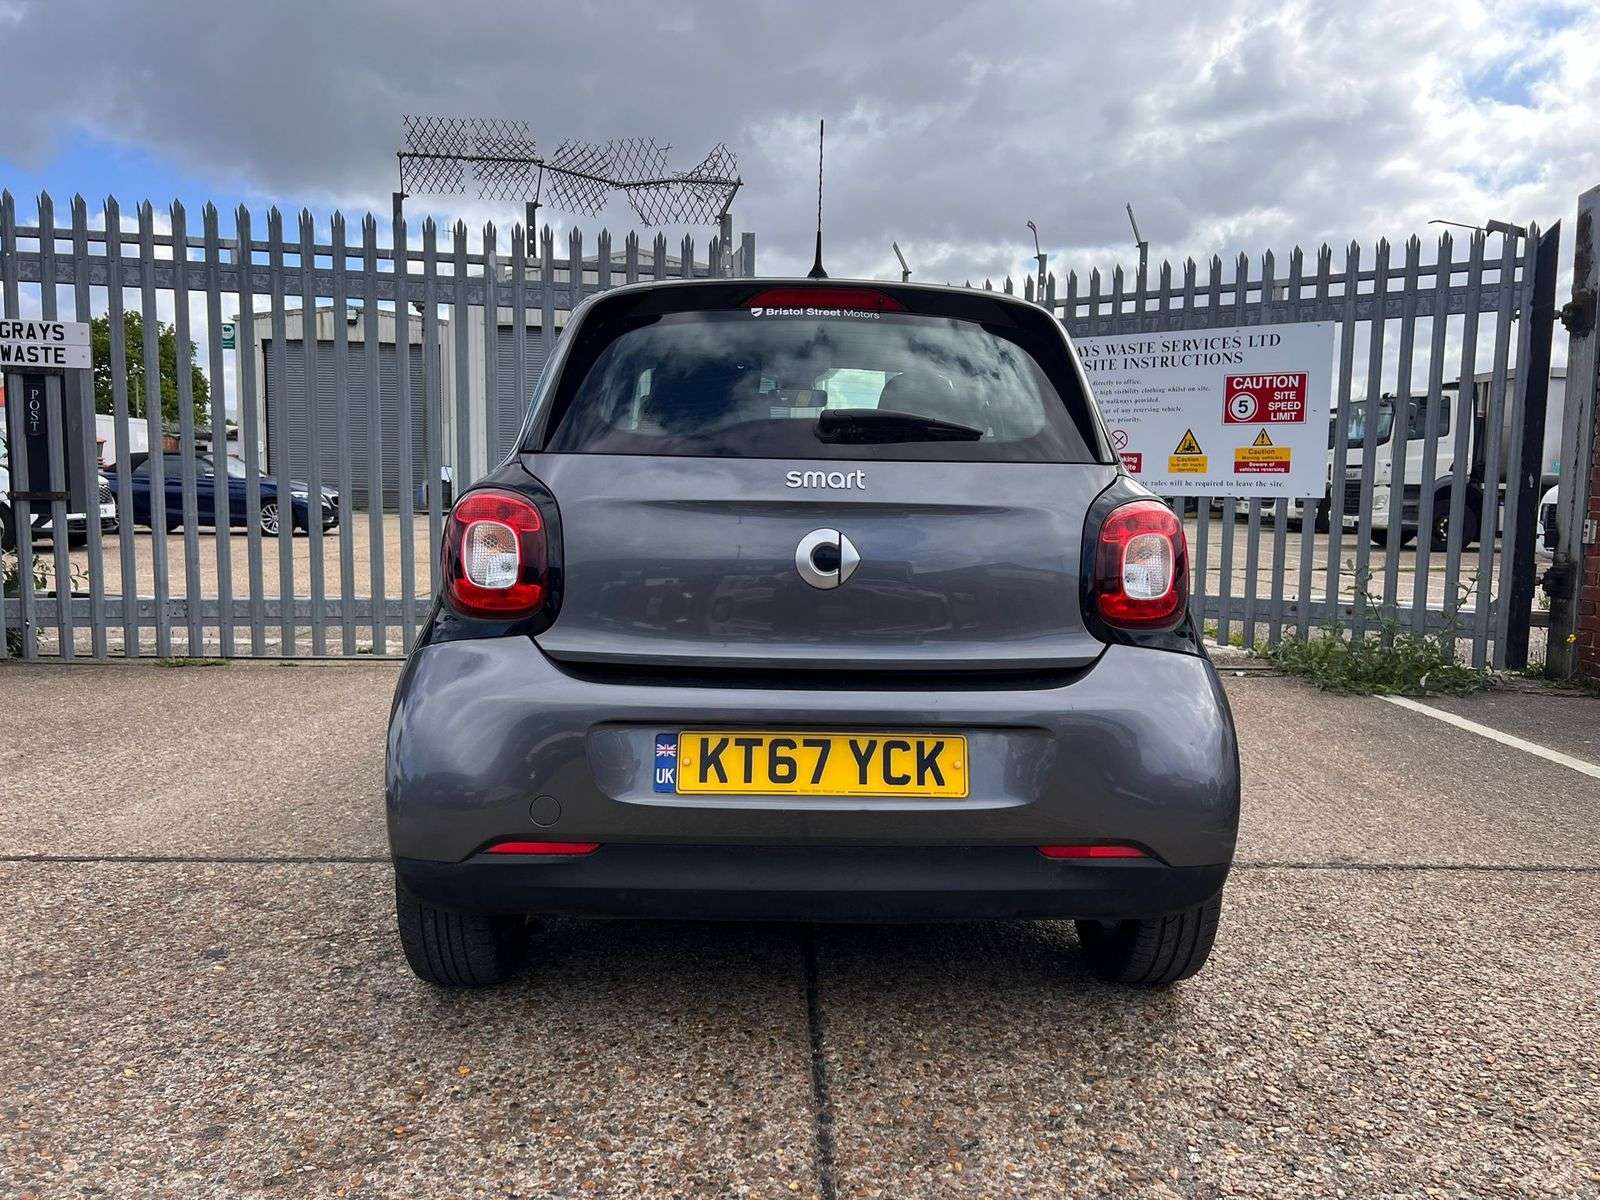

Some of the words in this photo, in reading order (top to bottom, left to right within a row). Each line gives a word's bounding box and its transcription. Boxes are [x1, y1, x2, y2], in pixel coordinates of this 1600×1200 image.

[766, 307, 803, 316] Bristol
[806, 307, 841, 317] Street
[844, 309, 880, 320] Motors
[0, 321, 65, 341] GRAYS
[1076, 344, 1100, 358] AYS
[1105, 341, 1156, 356] WASTE
[1161, 335, 1242, 353] SERVICES
[1249, 333, 1281, 348] LTD
[0, 344, 67, 364] WASTE
[1084, 358, 1117, 372] SITE
[1123, 351, 1243, 370] INSTRUCTIONS
[1232, 375, 1299, 390] CAUTION
[1273, 390, 1297, 400] SITE
[29, 389, 40, 432] POST
[1237, 400, 1249, 414] 5
[1267, 401, 1302, 411] SPEED
[1270, 411, 1297, 421] LIMIT
[785, 469, 866, 489] smart
[1195, 480, 1224, 488] required
[698, 737, 832, 785] KT67
[848, 740, 945, 787] YCK
[656, 768, 674, 784] UK
